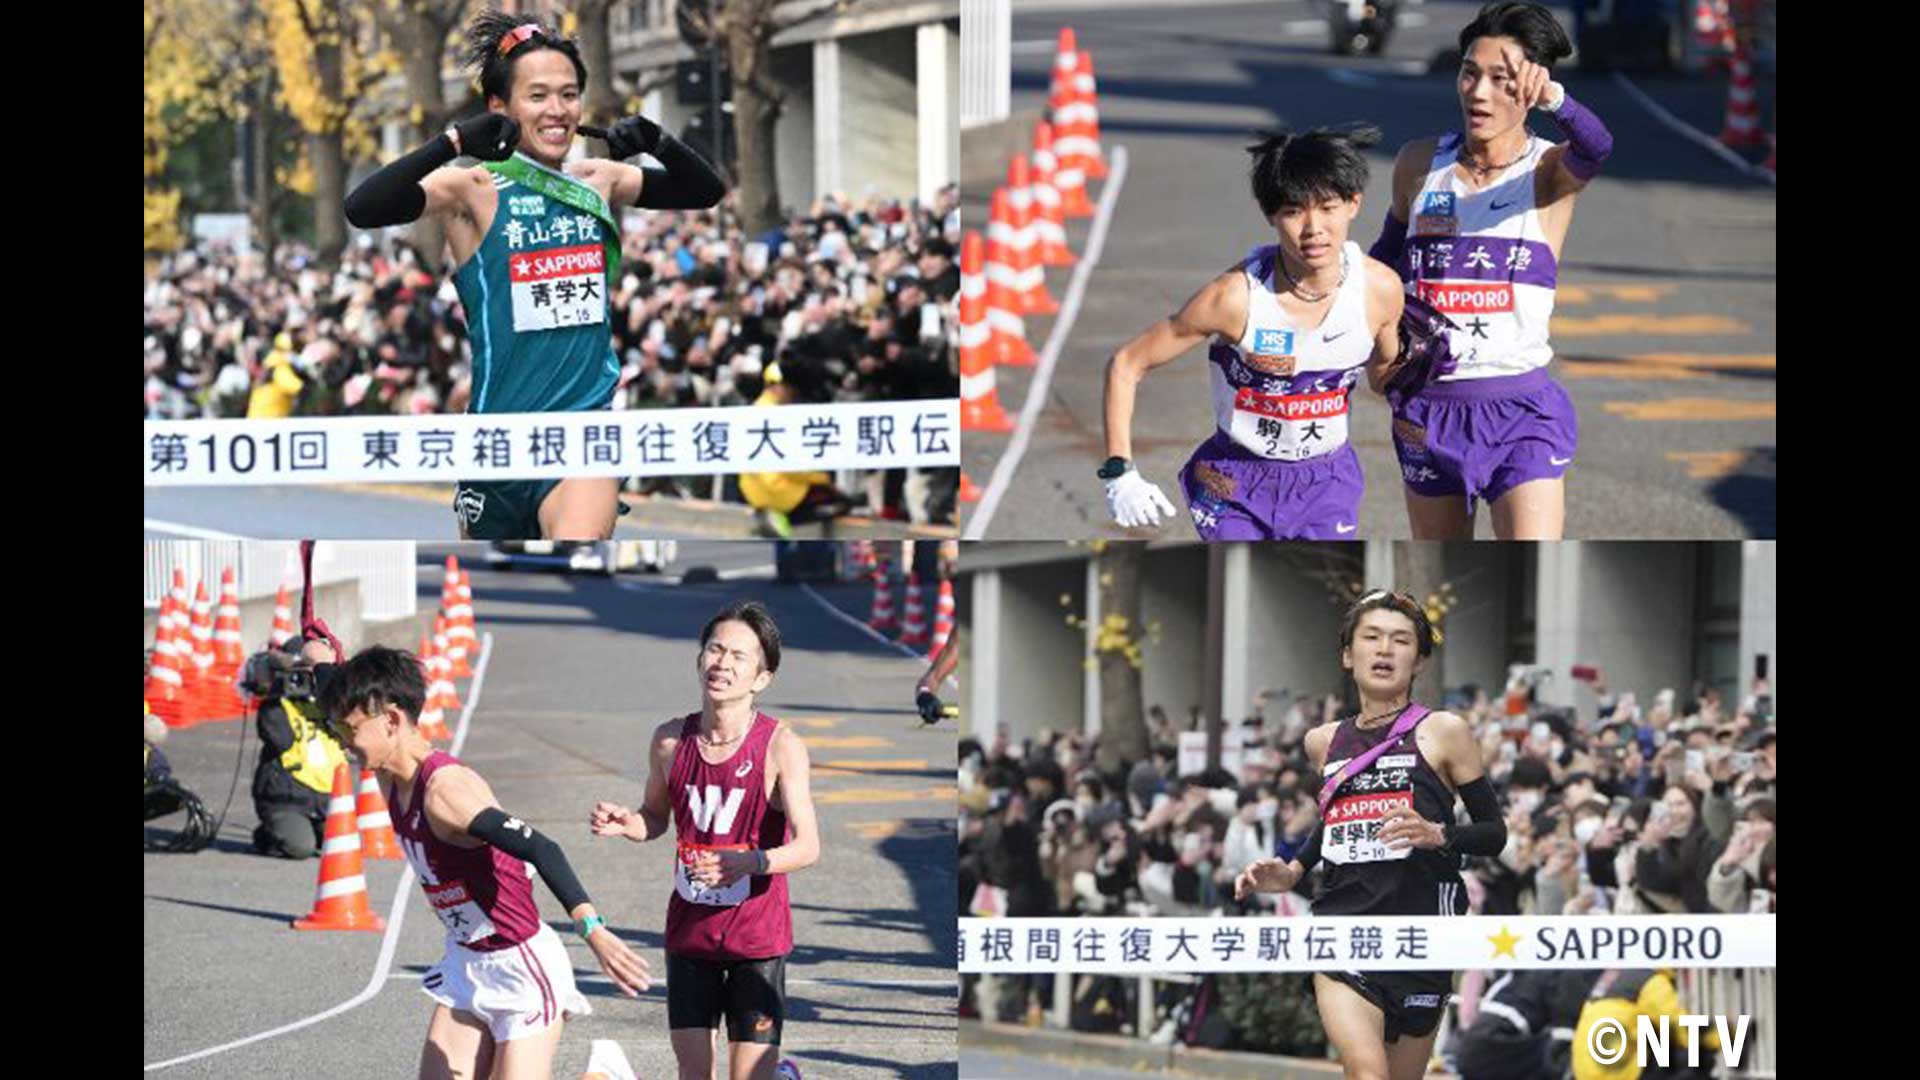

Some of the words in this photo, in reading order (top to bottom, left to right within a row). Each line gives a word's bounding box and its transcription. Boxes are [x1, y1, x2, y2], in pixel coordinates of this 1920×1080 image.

[503, 214, 600, 249] 青山学院
[530, 277, 601, 308] 青学大
[1263, 395, 1345, 415] SAPPORO
[150, 430, 328, 474] 第101回
[362, 412, 951, 469] 東京箱根間往復大学駅伝
[1256, 417, 1325, 443] 駒大
[685, 784, 746, 835] W
[1535, 926, 1723, 961] SAPPORO
